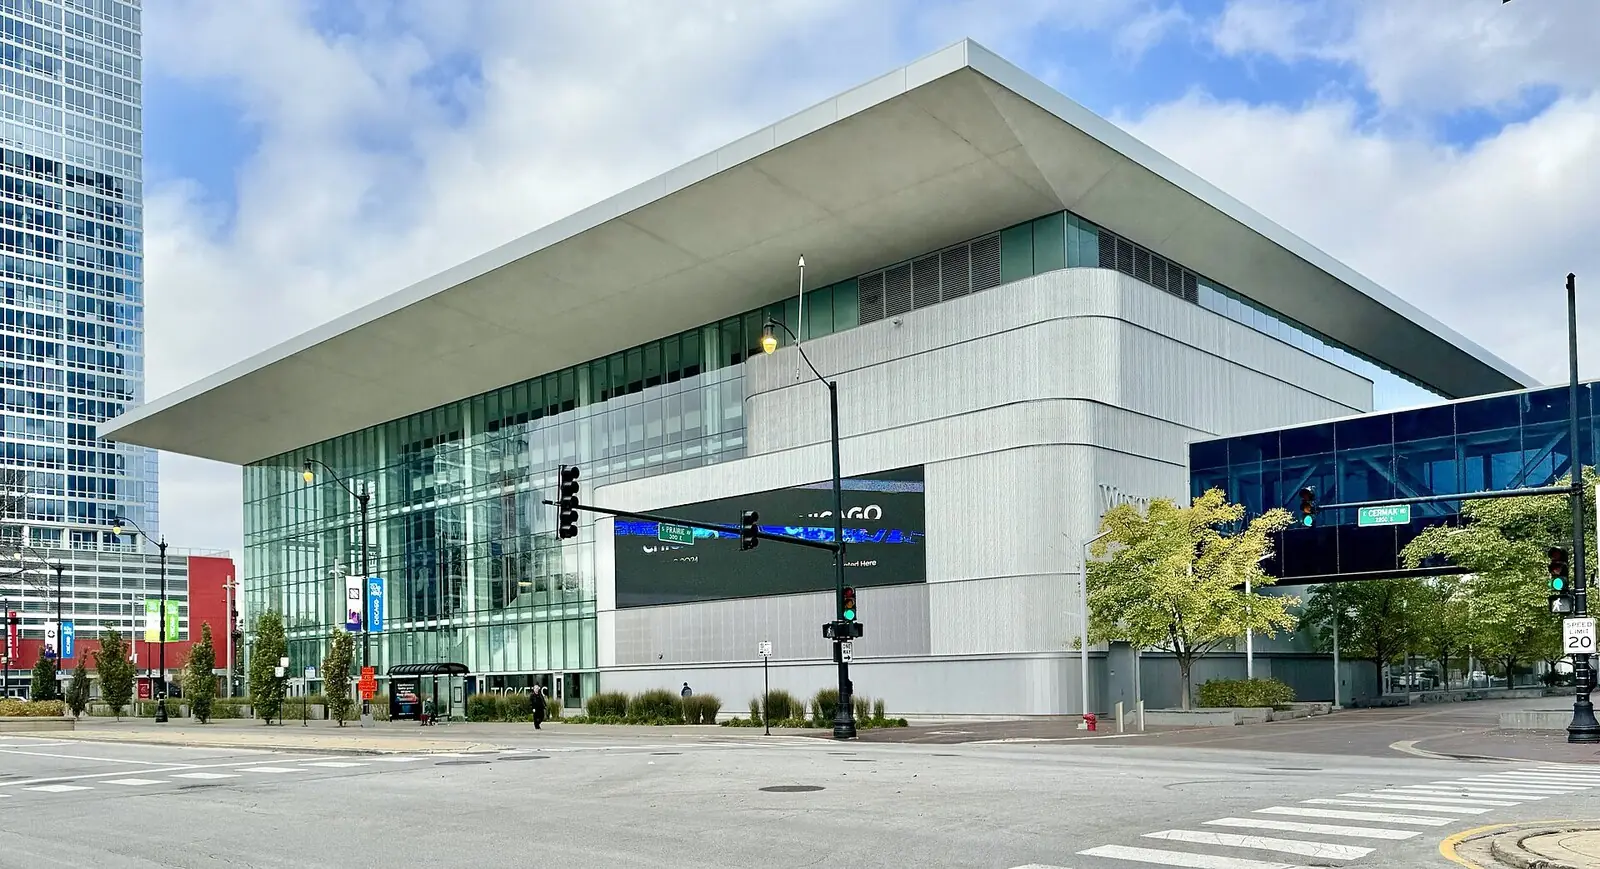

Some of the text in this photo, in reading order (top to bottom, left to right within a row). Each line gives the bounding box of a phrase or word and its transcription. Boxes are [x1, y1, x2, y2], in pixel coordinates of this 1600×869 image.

[1368, 507, 1399, 518] CERMAK
[665, 526, 686, 536] PRAIRIE
[1569, 636, 1591, 648] 20
[490, 686, 548, 699] TICKES
